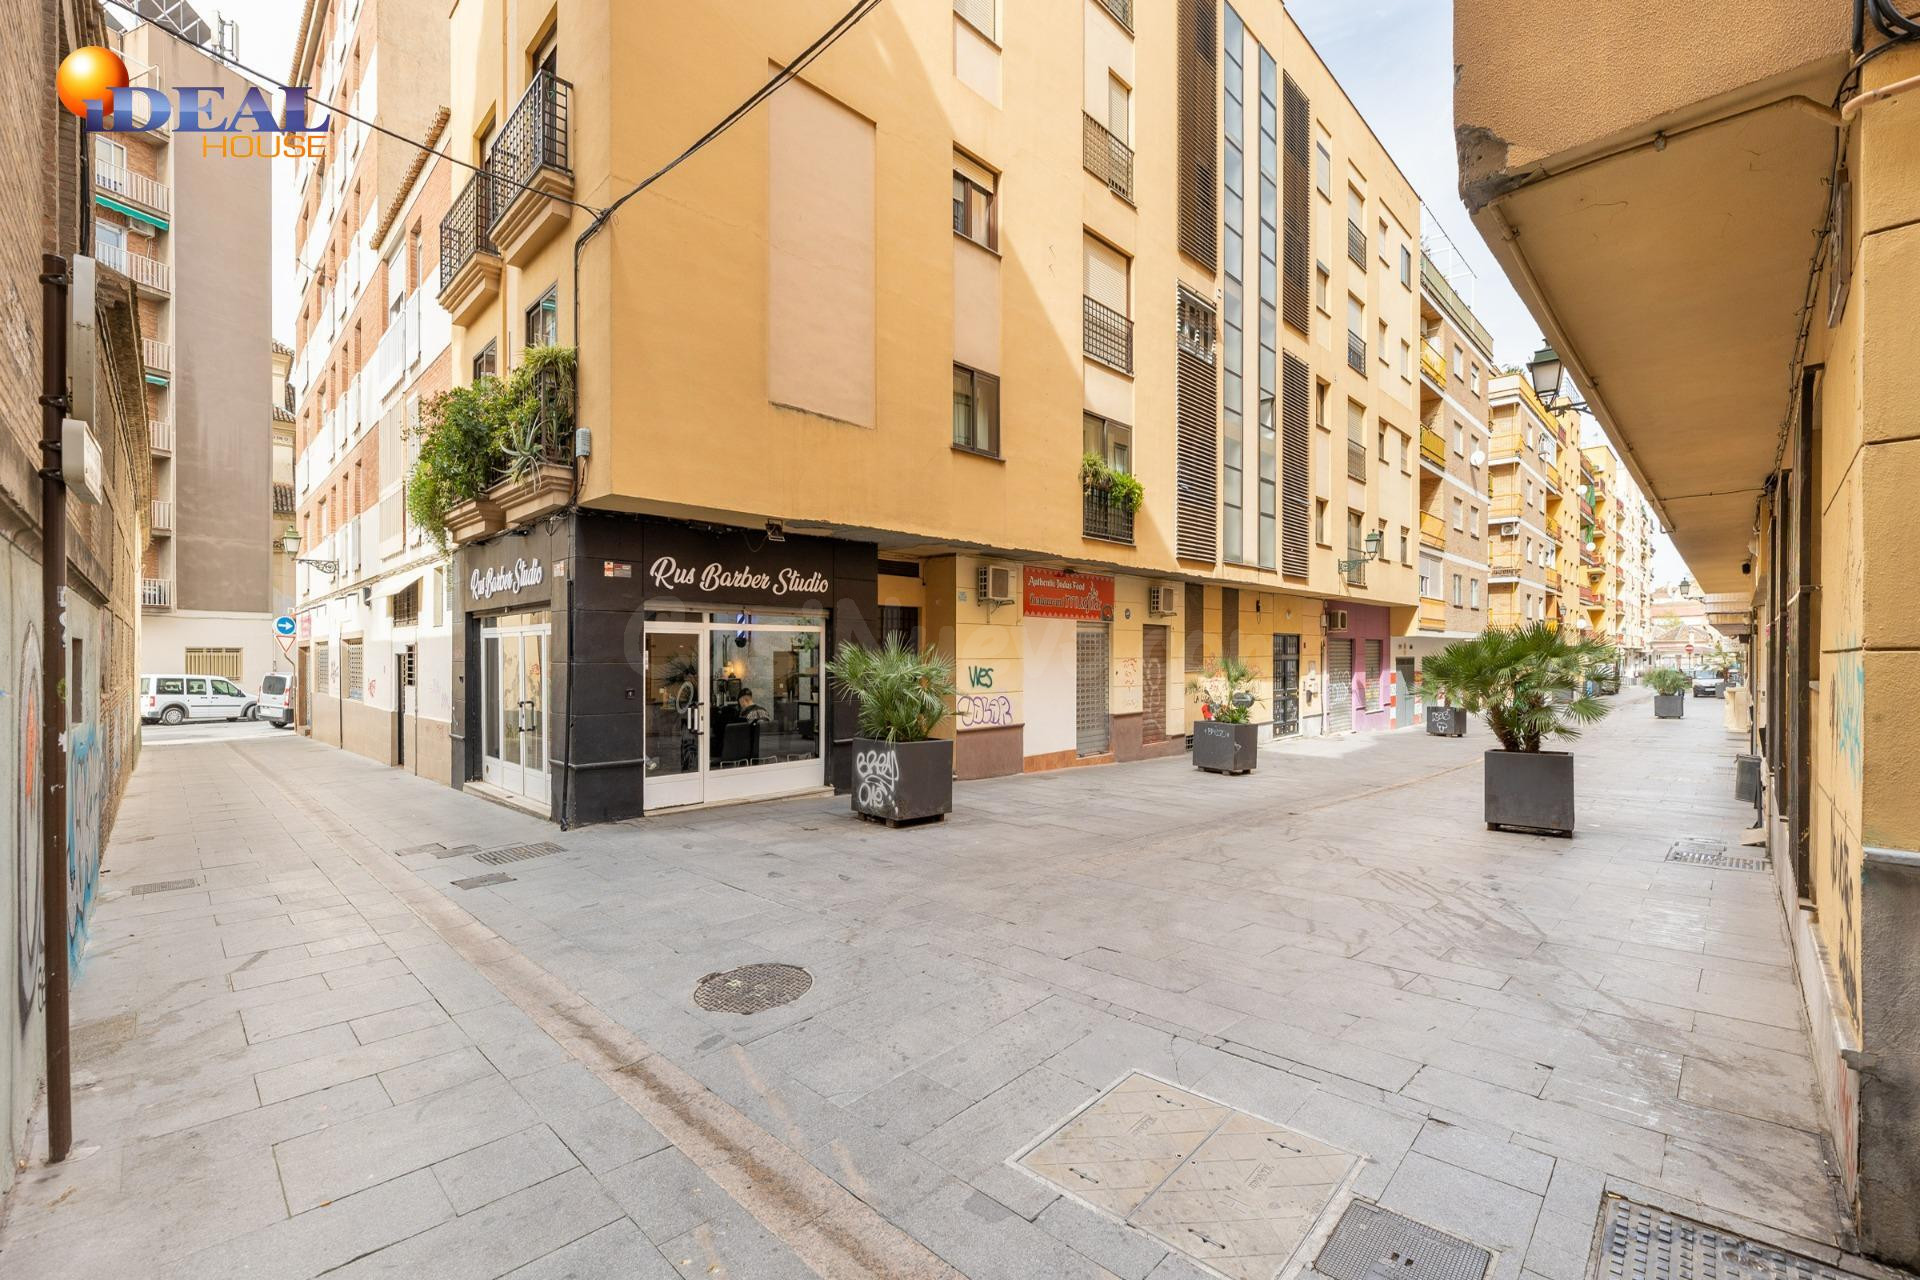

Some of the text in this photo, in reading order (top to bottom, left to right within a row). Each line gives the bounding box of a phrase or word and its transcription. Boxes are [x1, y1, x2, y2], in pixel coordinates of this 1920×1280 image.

[471, 569, 485, 600] Rus
[485, 566, 513, 598] Barber
[513, 558, 542, 594] Studio
[650, 556, 695, 589] Rus
[700, 562, 770, 591] Barber
[772, 568, 829, 595] Studio
[1028, 576, 1055, 587] Authentic
[1073, 581, 1085, 591] Food
